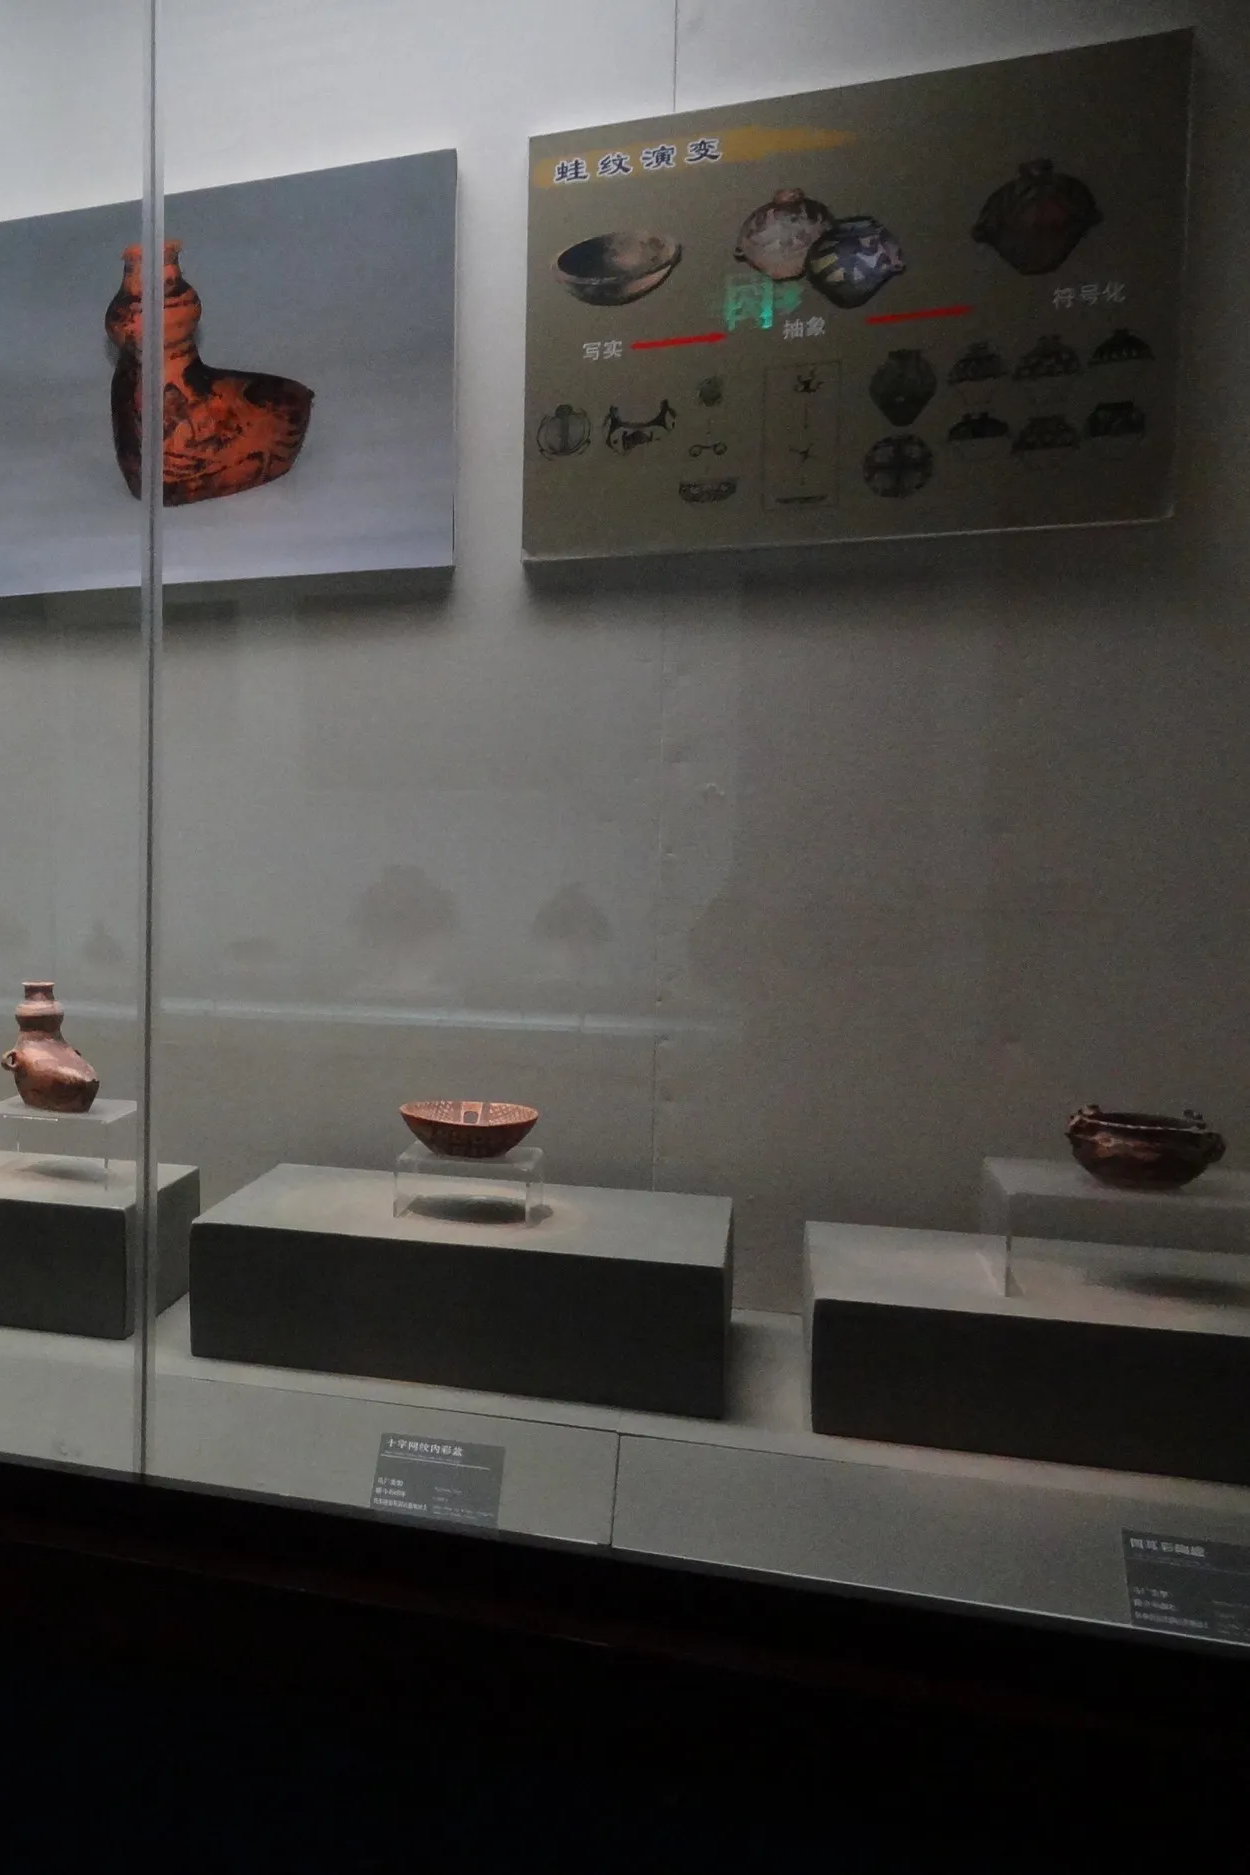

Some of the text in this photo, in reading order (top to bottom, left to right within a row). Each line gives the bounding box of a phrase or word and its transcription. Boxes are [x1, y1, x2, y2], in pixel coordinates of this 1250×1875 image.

[553, 137, 722, 184] 蛙纹演变
[1052, 280, 1126, 310] 符号化
[782, 315, 826, 340] 抽象
[582, 340, 623, 361] 写实
